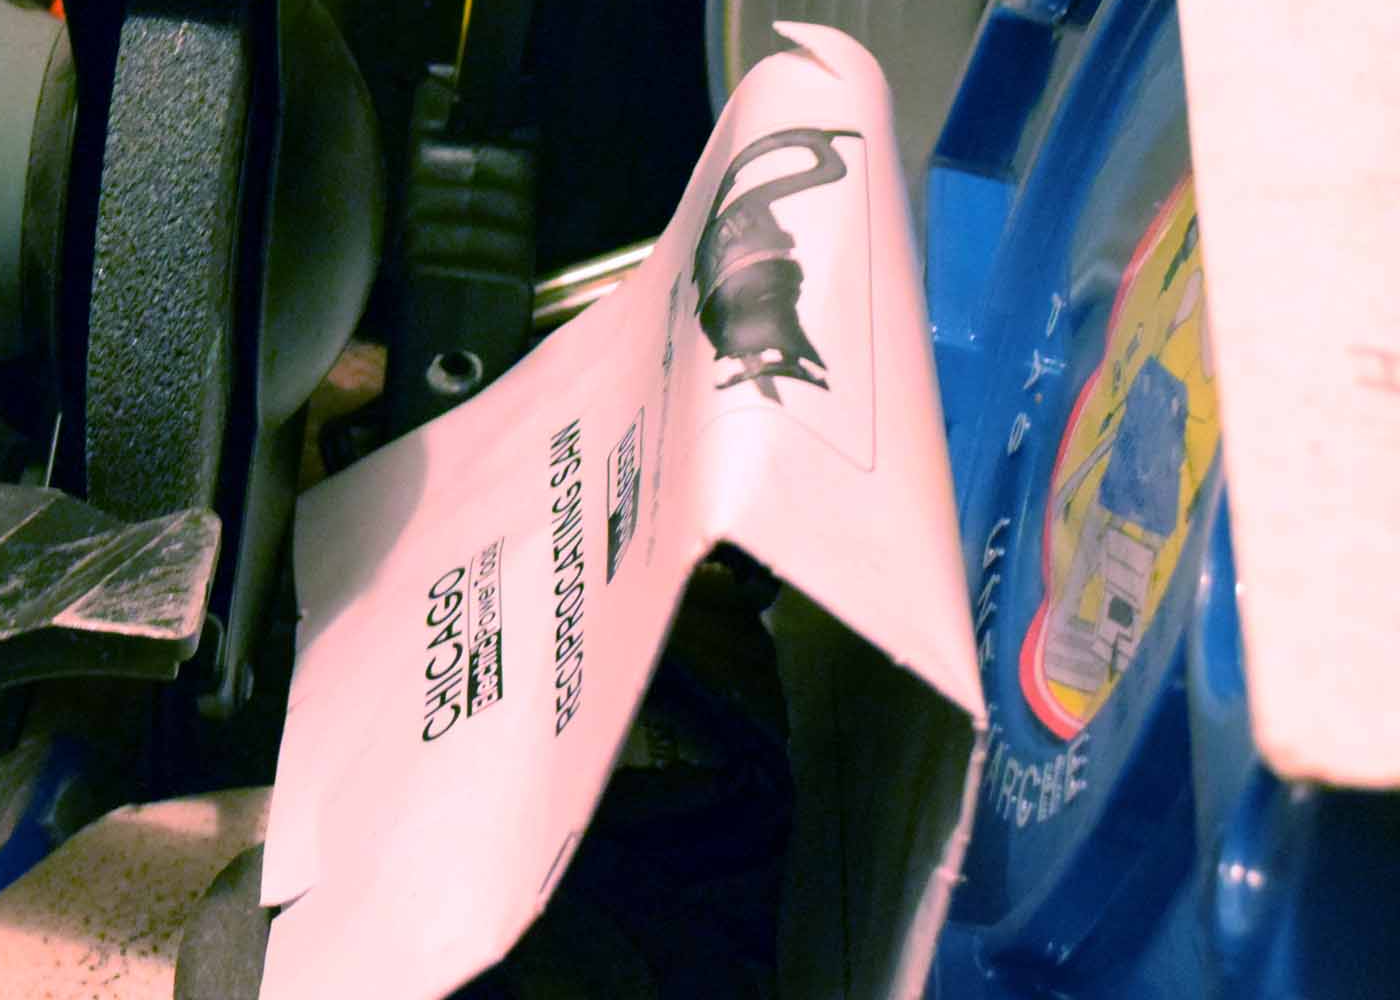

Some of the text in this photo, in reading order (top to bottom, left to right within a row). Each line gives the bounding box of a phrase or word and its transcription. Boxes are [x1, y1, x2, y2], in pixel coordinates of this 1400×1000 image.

[422, 566, 466, 741] CHICAGO
[549, 418, 585, 737] RECIPROCATING SAW
